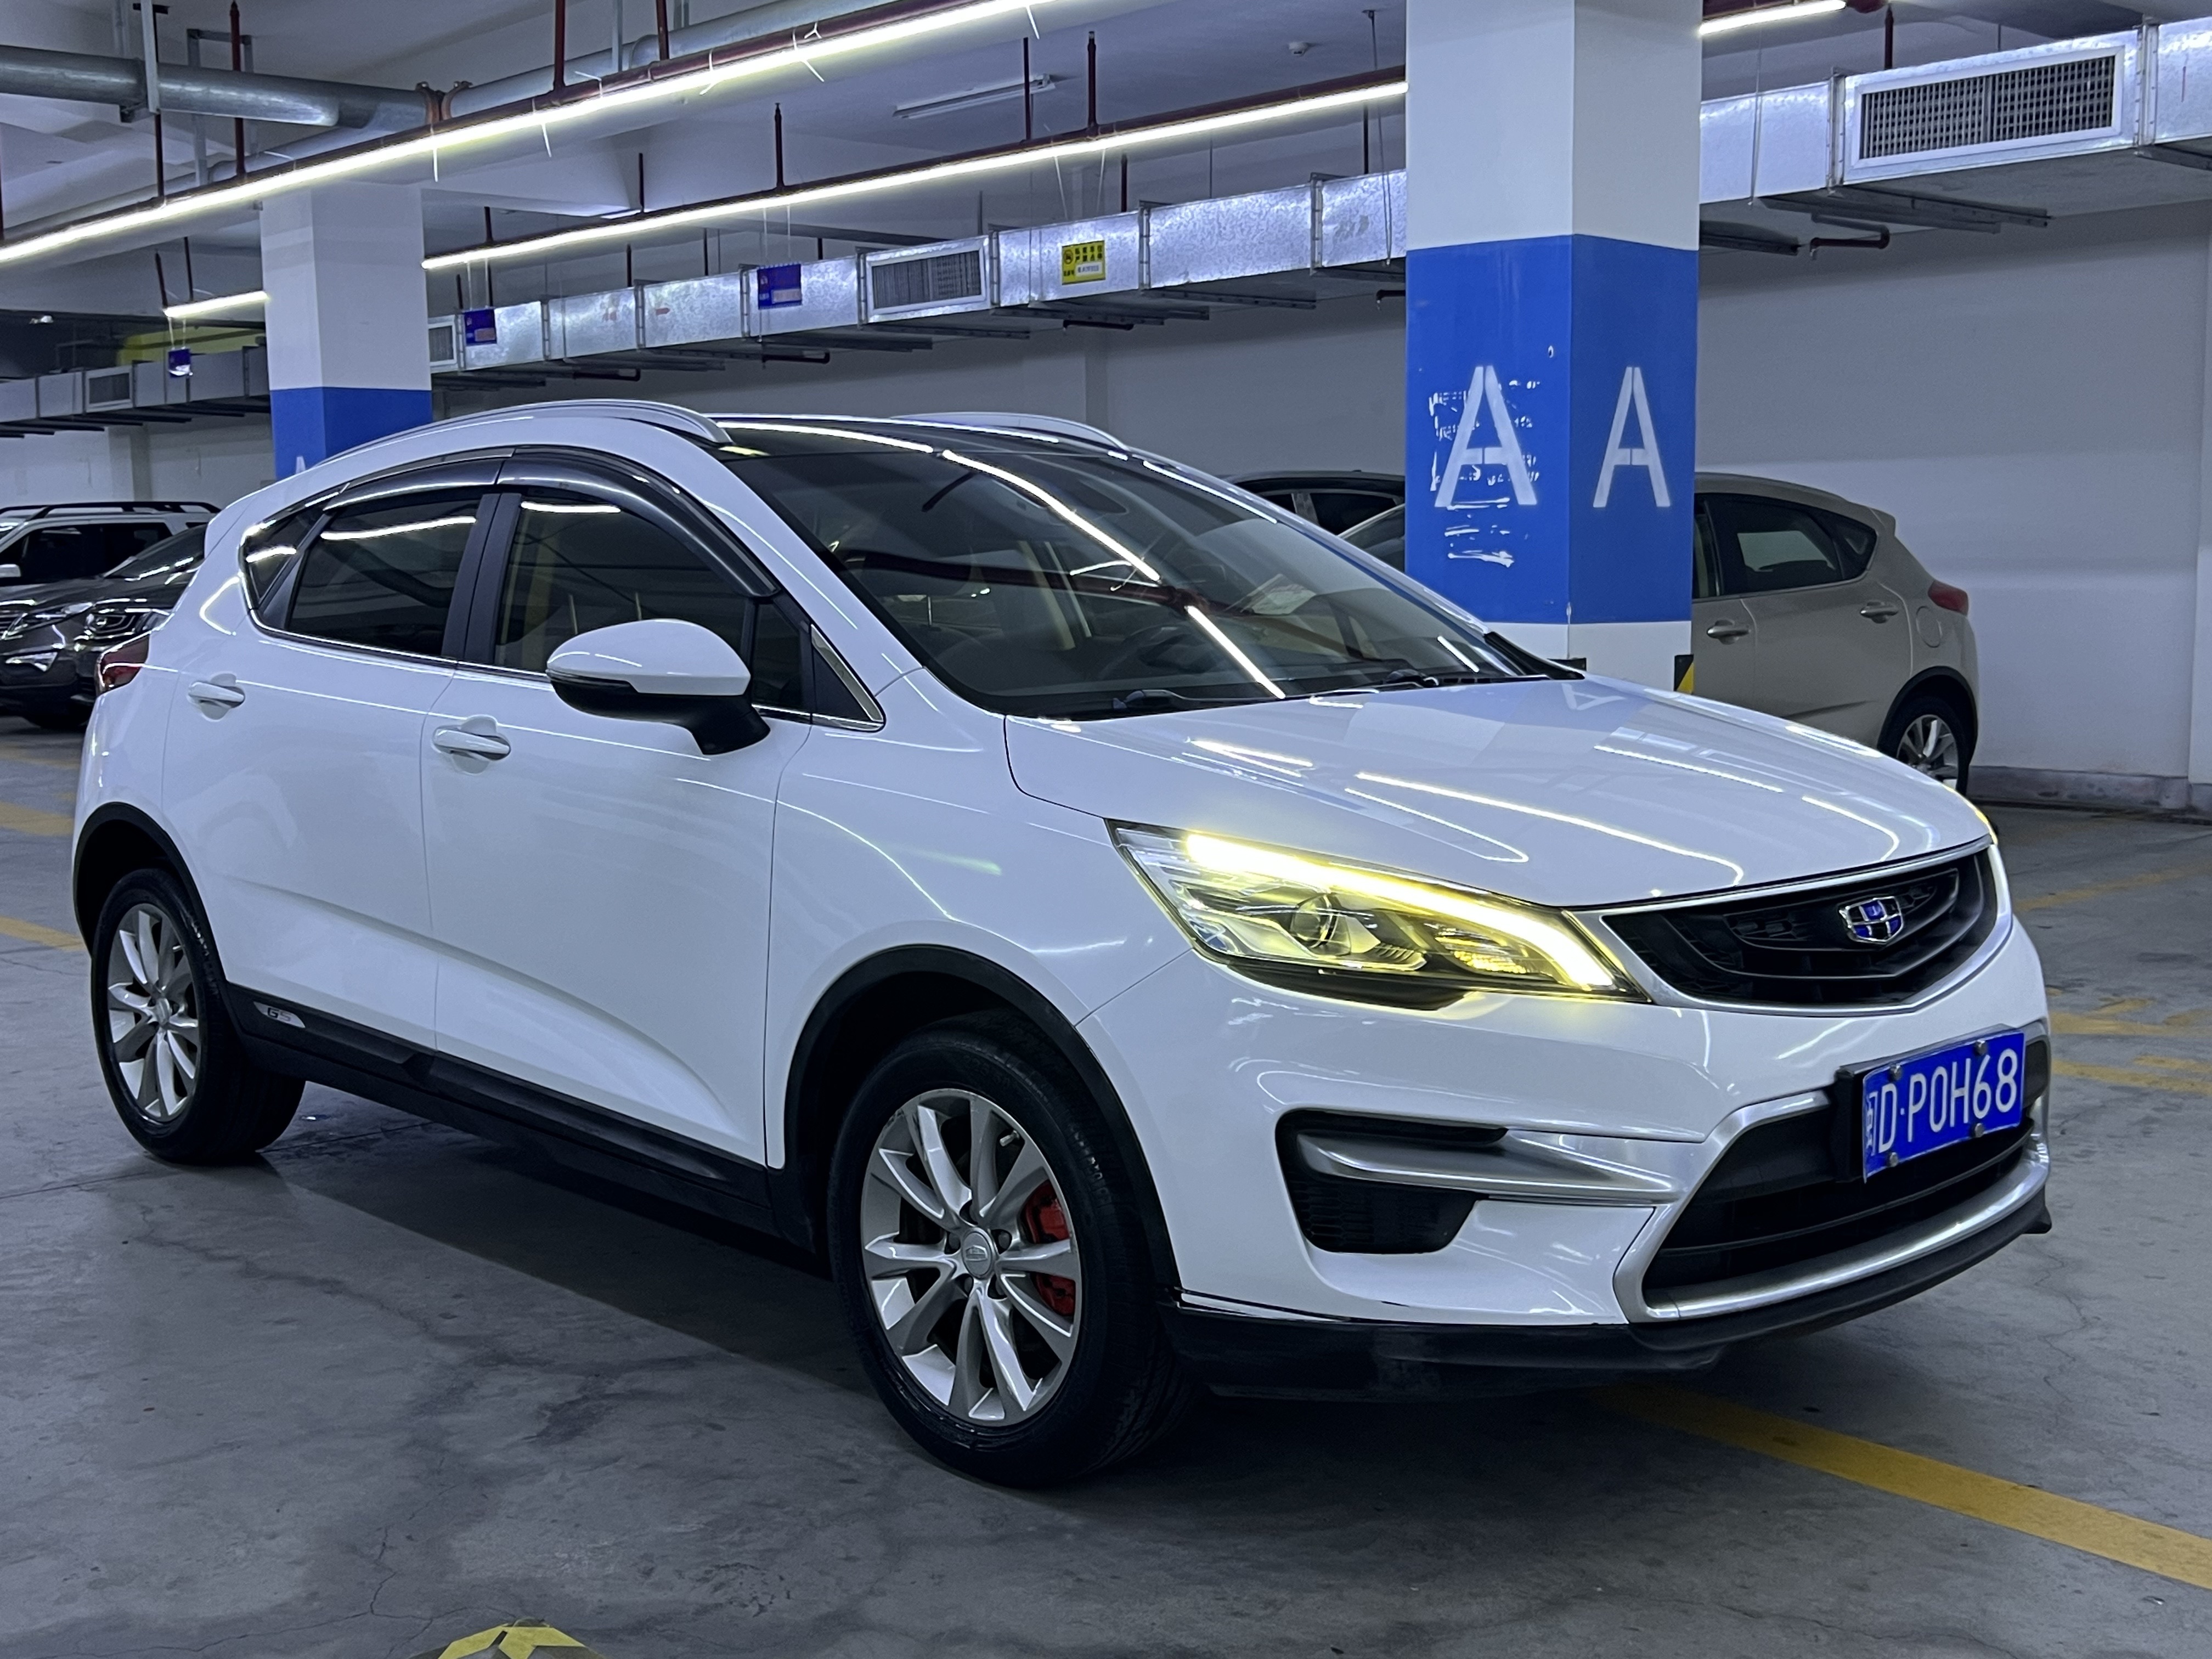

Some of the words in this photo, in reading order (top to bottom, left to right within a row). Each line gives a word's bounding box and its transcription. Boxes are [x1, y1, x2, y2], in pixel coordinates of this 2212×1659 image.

[1434, 365, 1537, 507] A
[1593, 366, 1671, 508] A
[267, 1007, 292, 1022] GS
